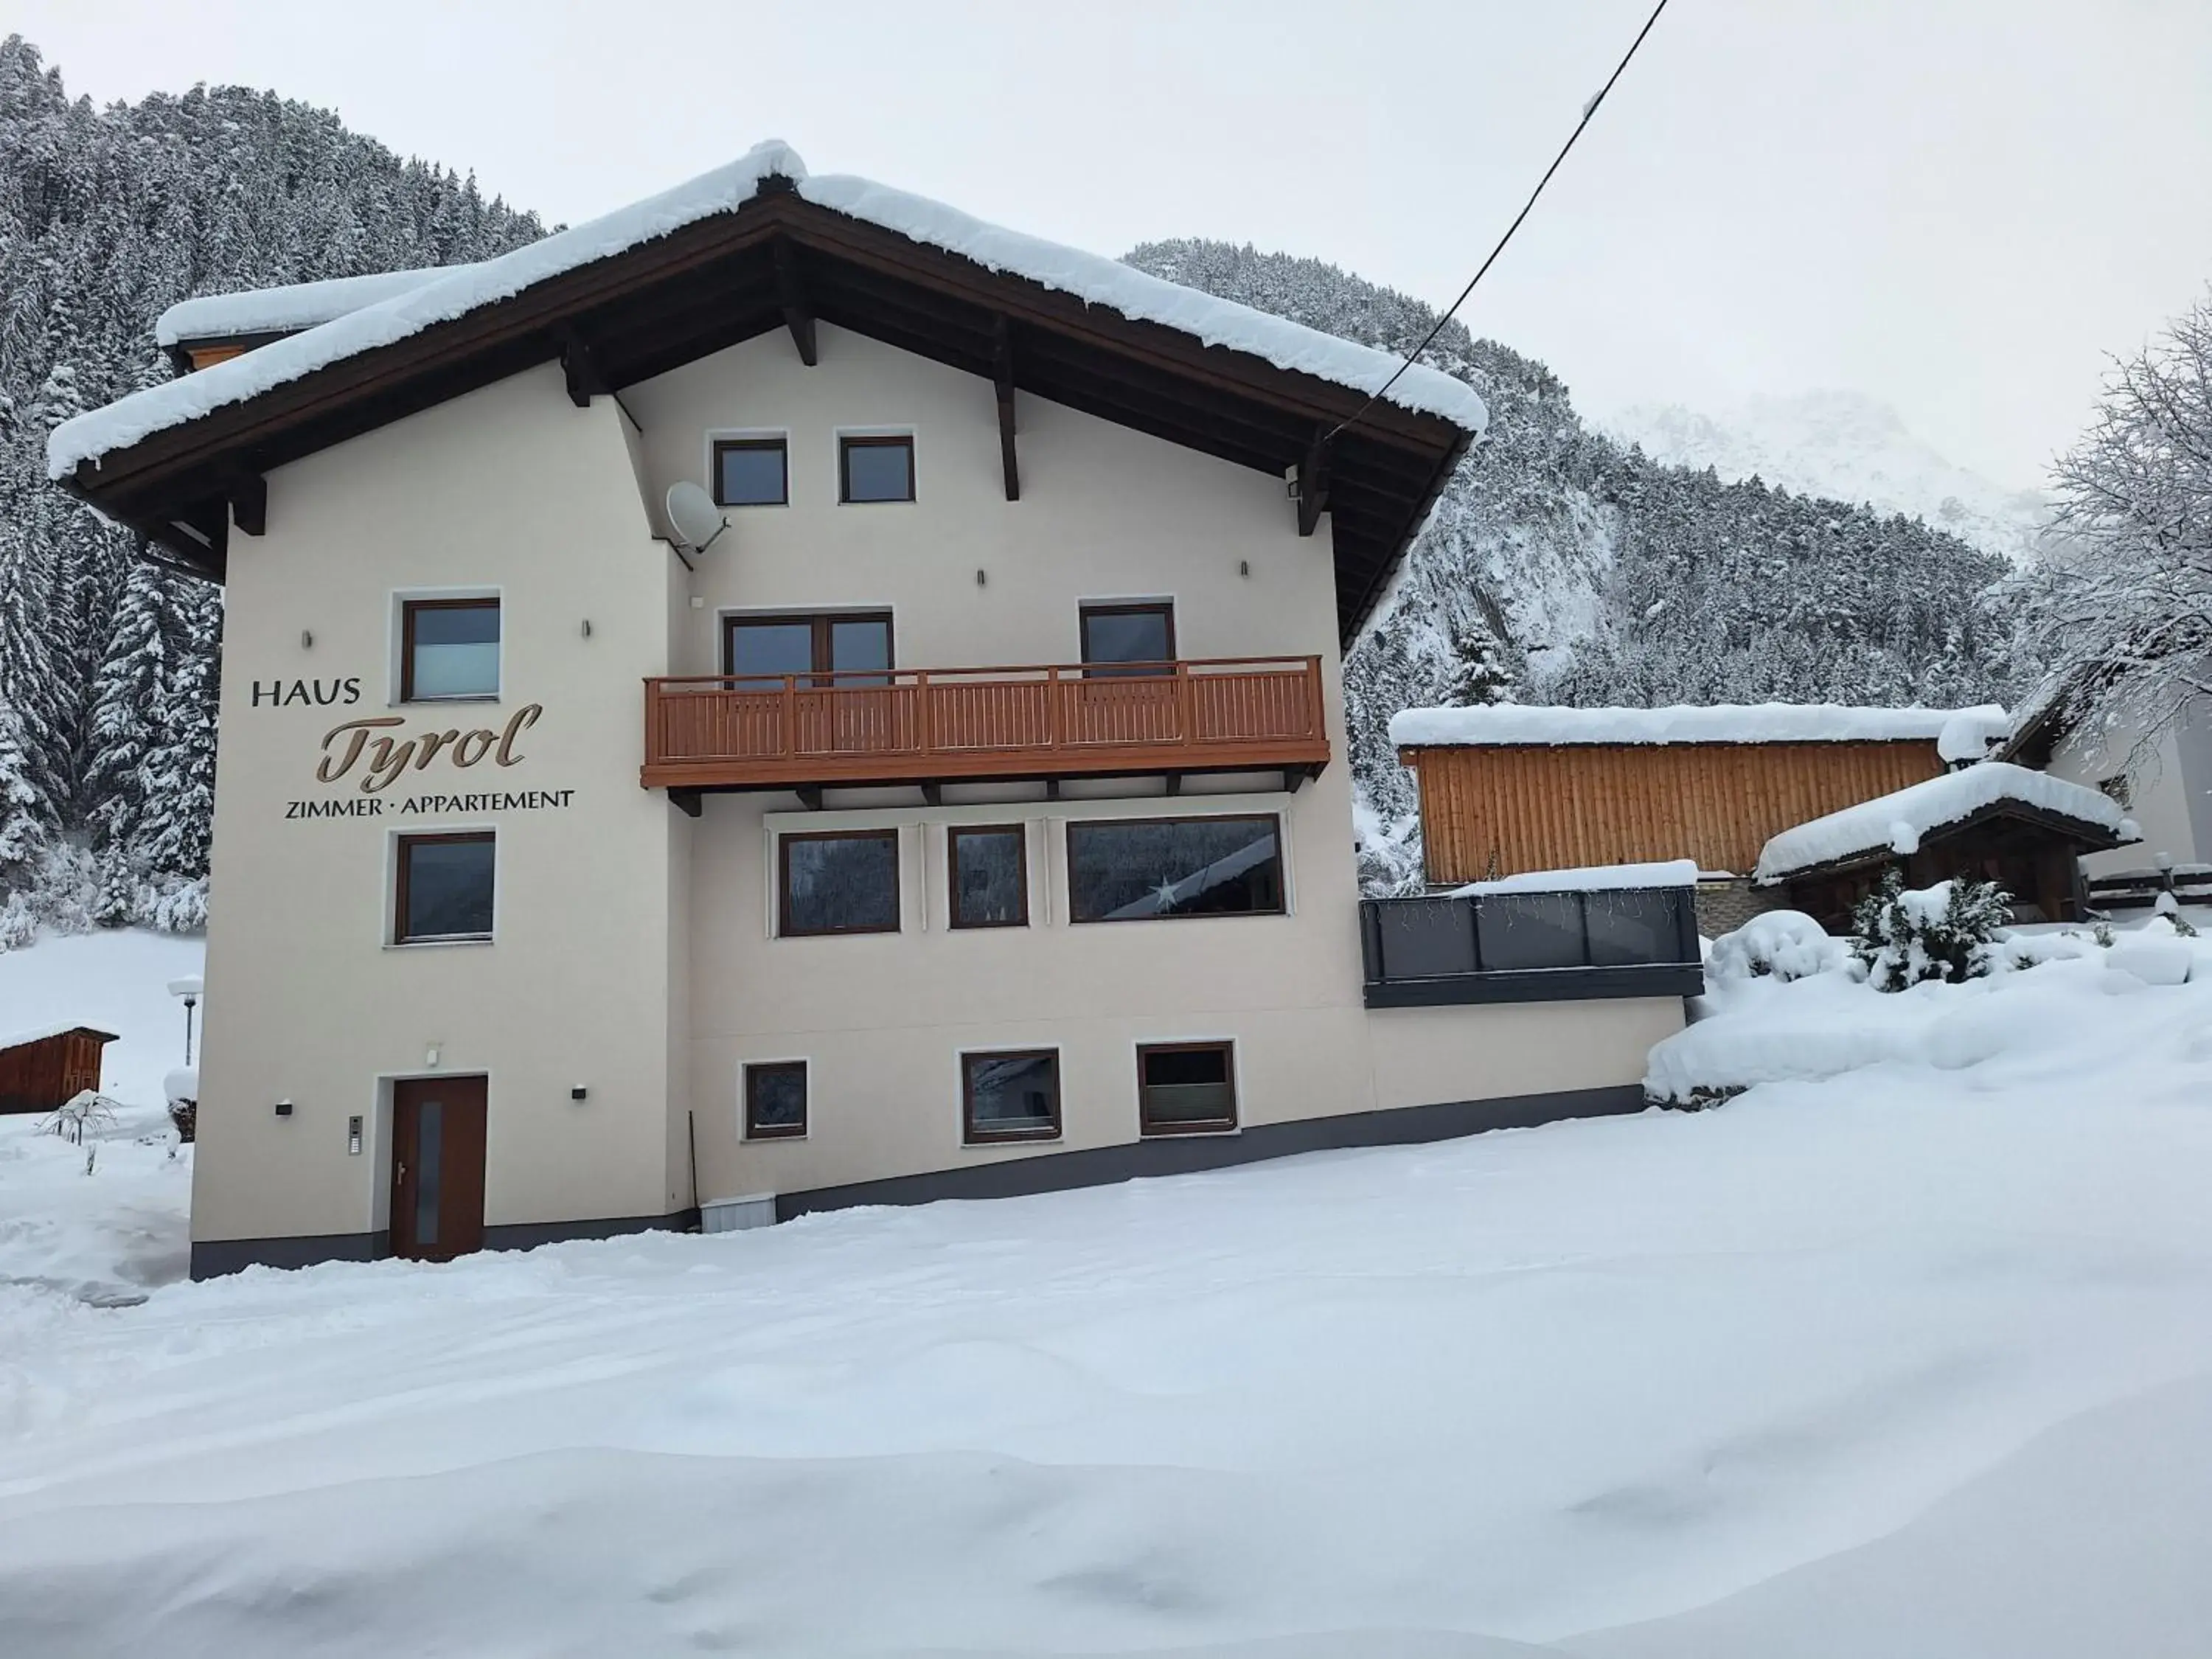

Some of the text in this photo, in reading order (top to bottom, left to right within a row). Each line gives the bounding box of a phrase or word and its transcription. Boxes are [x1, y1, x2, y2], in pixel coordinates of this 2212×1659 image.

[251, 678, 361, 707] HAUS
[316, 703, 543, 793] Tyrol
[285, 790, 575, 819] ZIMMER APPARTEMENT
